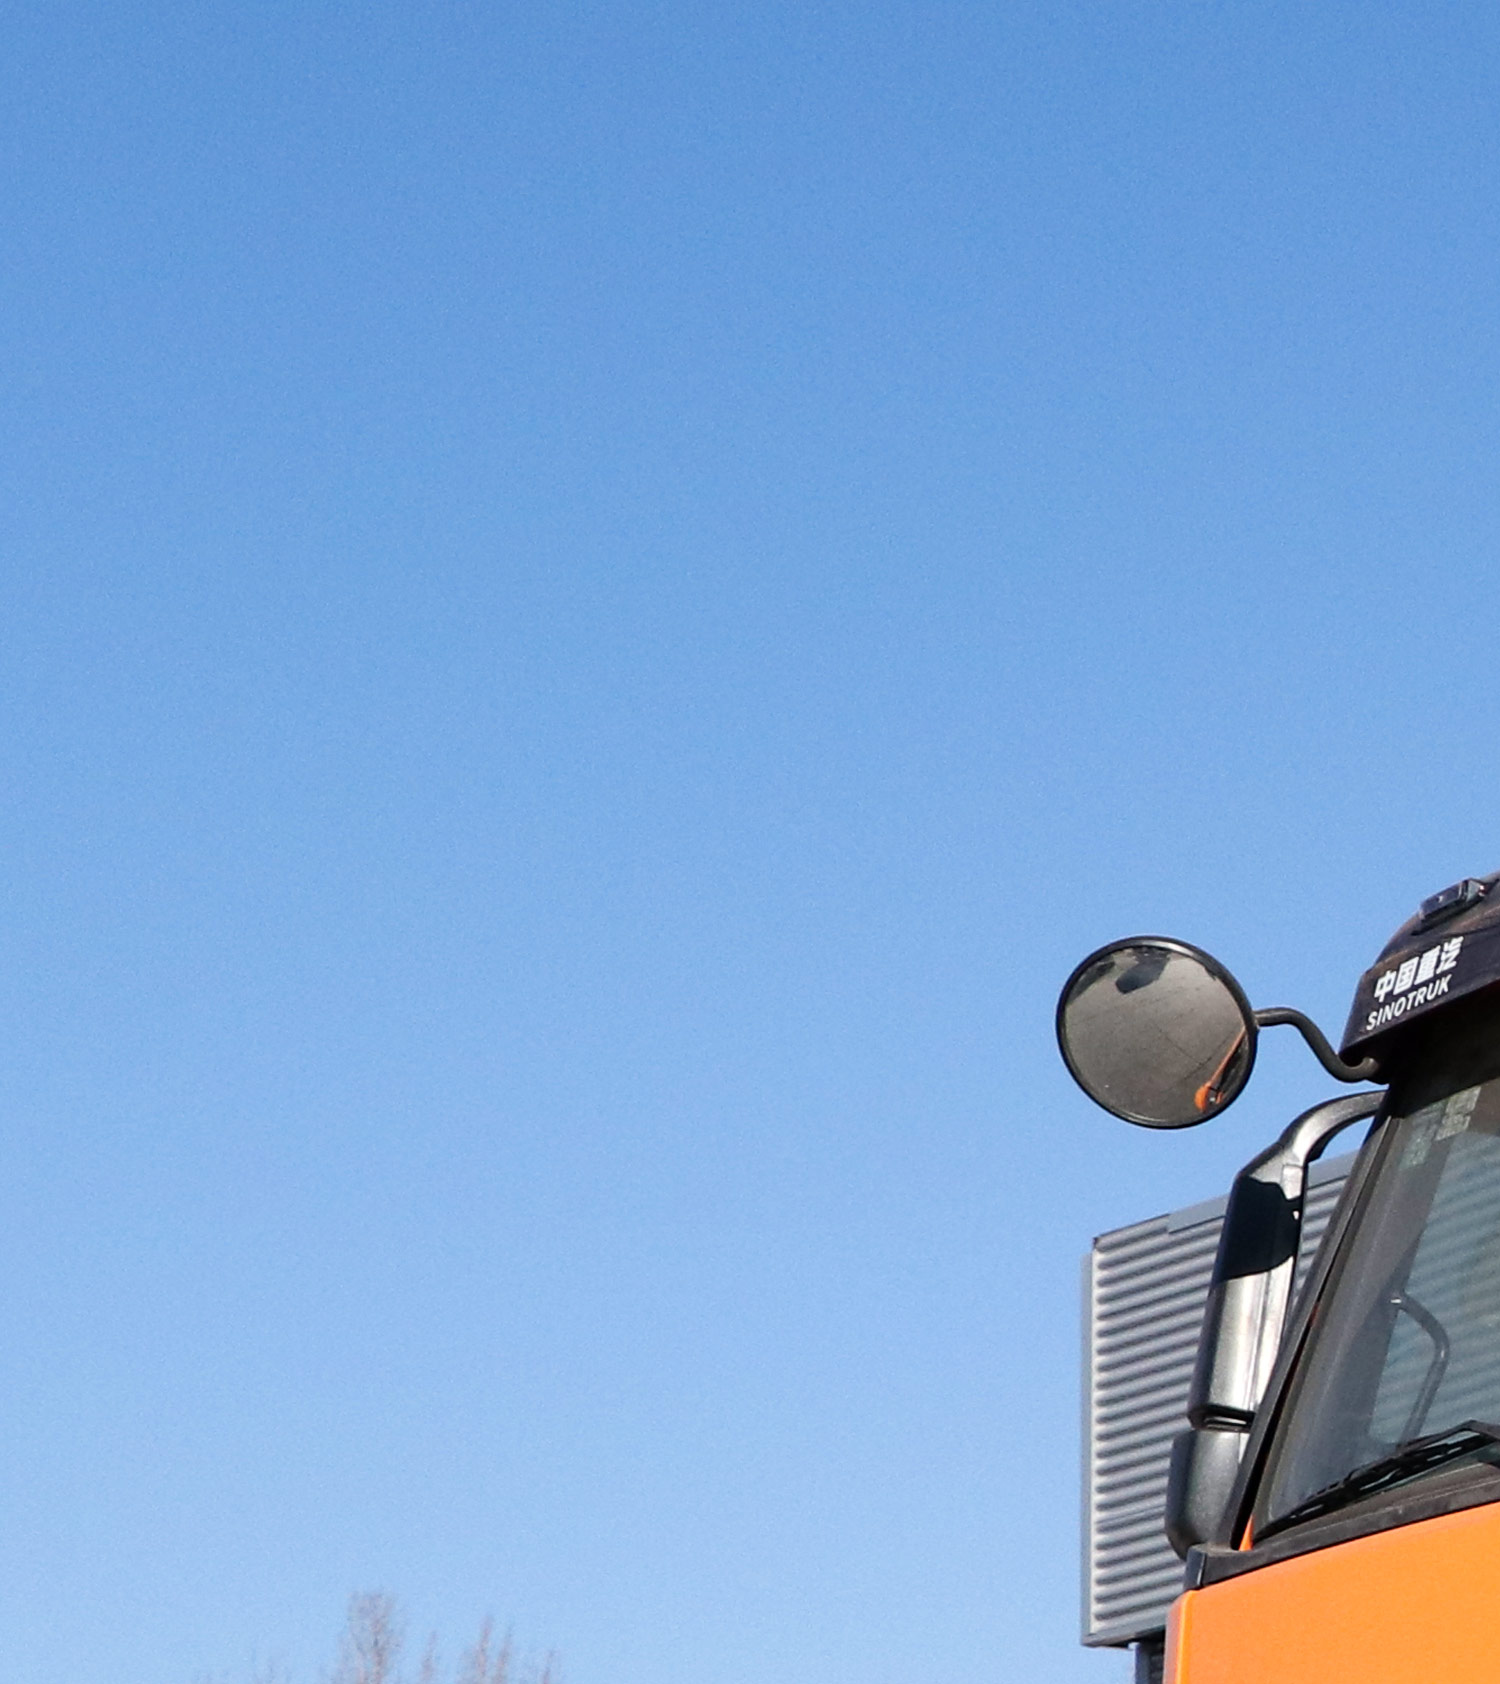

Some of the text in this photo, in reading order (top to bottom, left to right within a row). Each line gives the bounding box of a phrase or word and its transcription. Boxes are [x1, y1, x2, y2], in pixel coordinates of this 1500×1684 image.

[1373, 936, 1464, 1003] 中国重汽
[1366, 974, 1452, 1031] SINOTRUK
